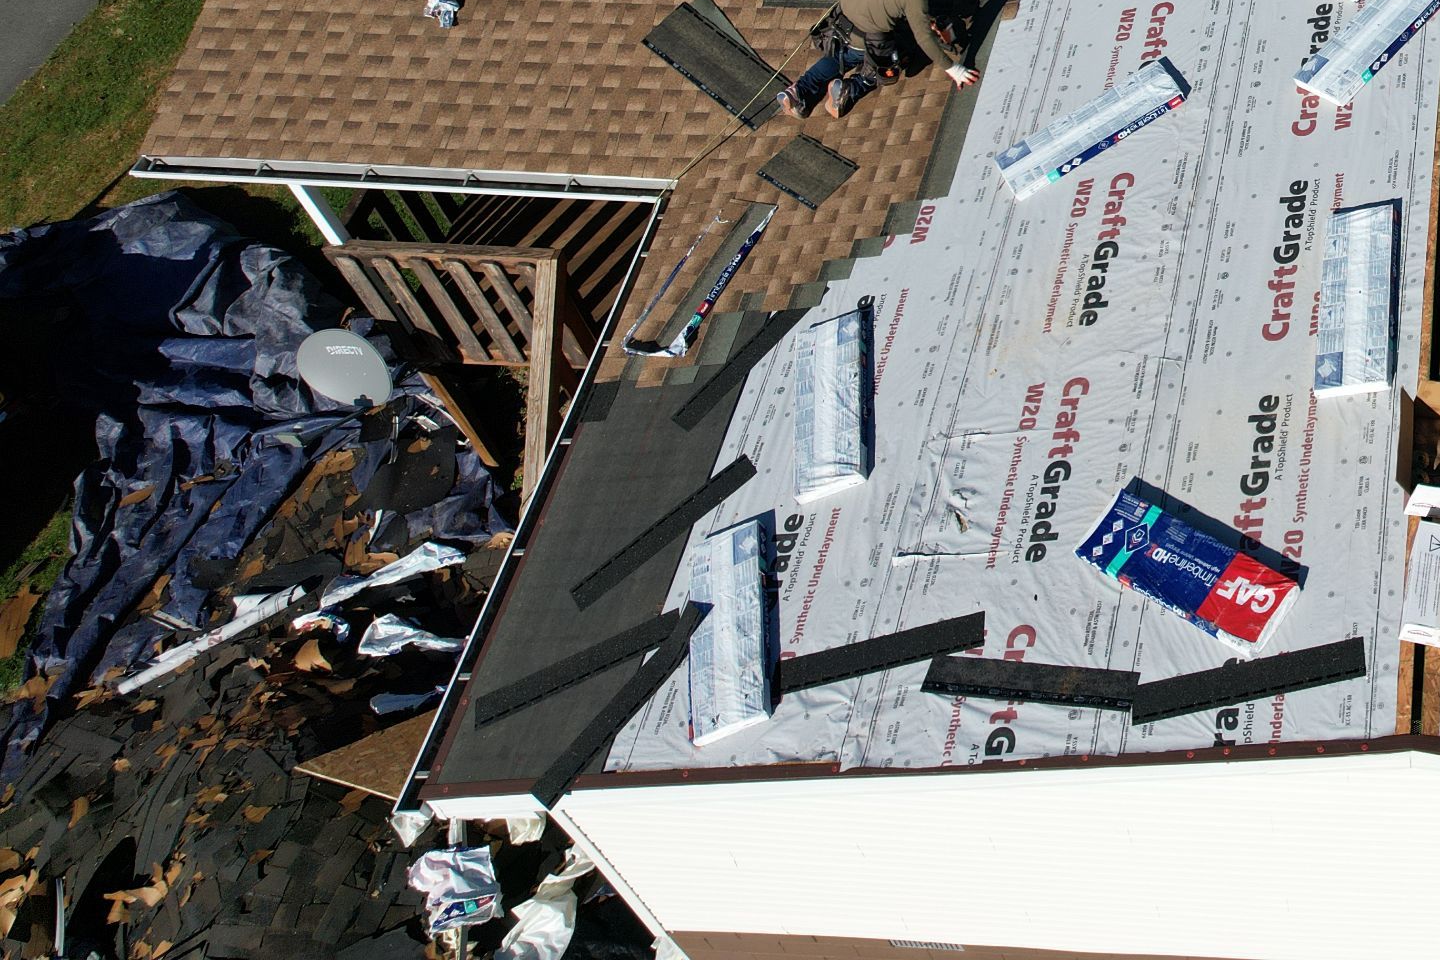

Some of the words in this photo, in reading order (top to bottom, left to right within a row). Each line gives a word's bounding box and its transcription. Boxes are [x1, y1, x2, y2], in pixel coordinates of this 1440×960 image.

[1115, 7, 1137, 42] W20
[1105, 45, 1123, 83] Synthetic
[1070, 178, 1094, 218] W20
[1310, 179, 1320, 206] Product
[910, 206, 936, 245] W20
[1060, 223, 1078, 264] Synthetic
[1305, 210, 1316, 244] TopShield
[1079, 172, 1134, 326] CraftGrade
[1262, 180, 1308, 341] CraftGrade
[1074, 260, 1086, 296] TopShield
[874, 293, 887, 322] Product
[1043, 265, 1067, 333] Underlayment
[1066, 299, 1078, 327] Product
[881, 287, 909, 353] Underlayment
[1019, 382, 1046, 430] W20
[1281, 394, 1293, 427] Product
[1006, 436, 1028, 487] Synthetic
[1025, 377, 1090, 563] CraftGrade
[1276, 430, 1288, 471] TopShield
[1021, 482, 1038, 524] TopShield
[1294, 472, 1309, 523] Synthetic
[985, 488, 1016, 570] Underlayment
[1011, 528, 1027, 564] Product
[787, 550, 805, 594] TopShield
[800, 513, 817, 546] Product
[790, 590, 816, 645] Synthetic
[808, 507, 842, 588] Underlayment
[1216, 576, 1275, 613] GAF
